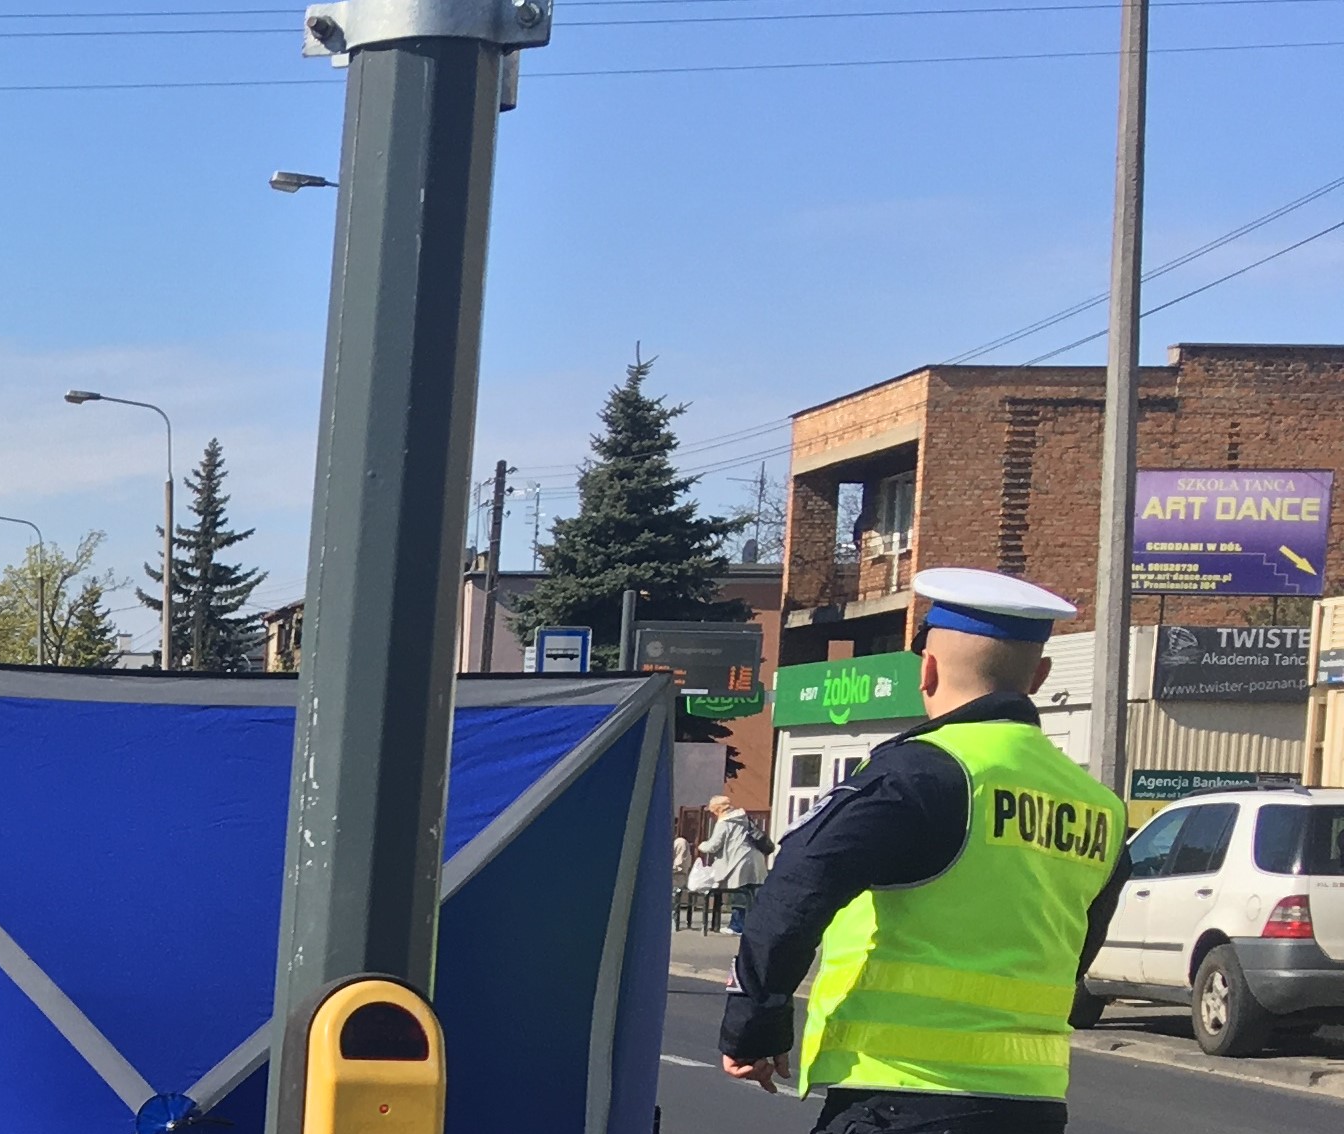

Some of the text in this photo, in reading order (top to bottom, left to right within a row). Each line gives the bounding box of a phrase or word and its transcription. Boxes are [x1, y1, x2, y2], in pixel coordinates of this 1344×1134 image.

[1176, 477, 1239, 491] SZKOŁA
[1141, 496, 1321, 521] ART DANCE
[1146, 541, 1242, 552] SCHODAMI W DÓŁ
[1201, 653, 1269, 666] Akademia
[1274, 653, 1309, 666] Tańc
[822, 667, 871, 707] żabka
[1136, 775, 1189, 790] Agencja
[993, 788, 1108, 862] POLICJA
